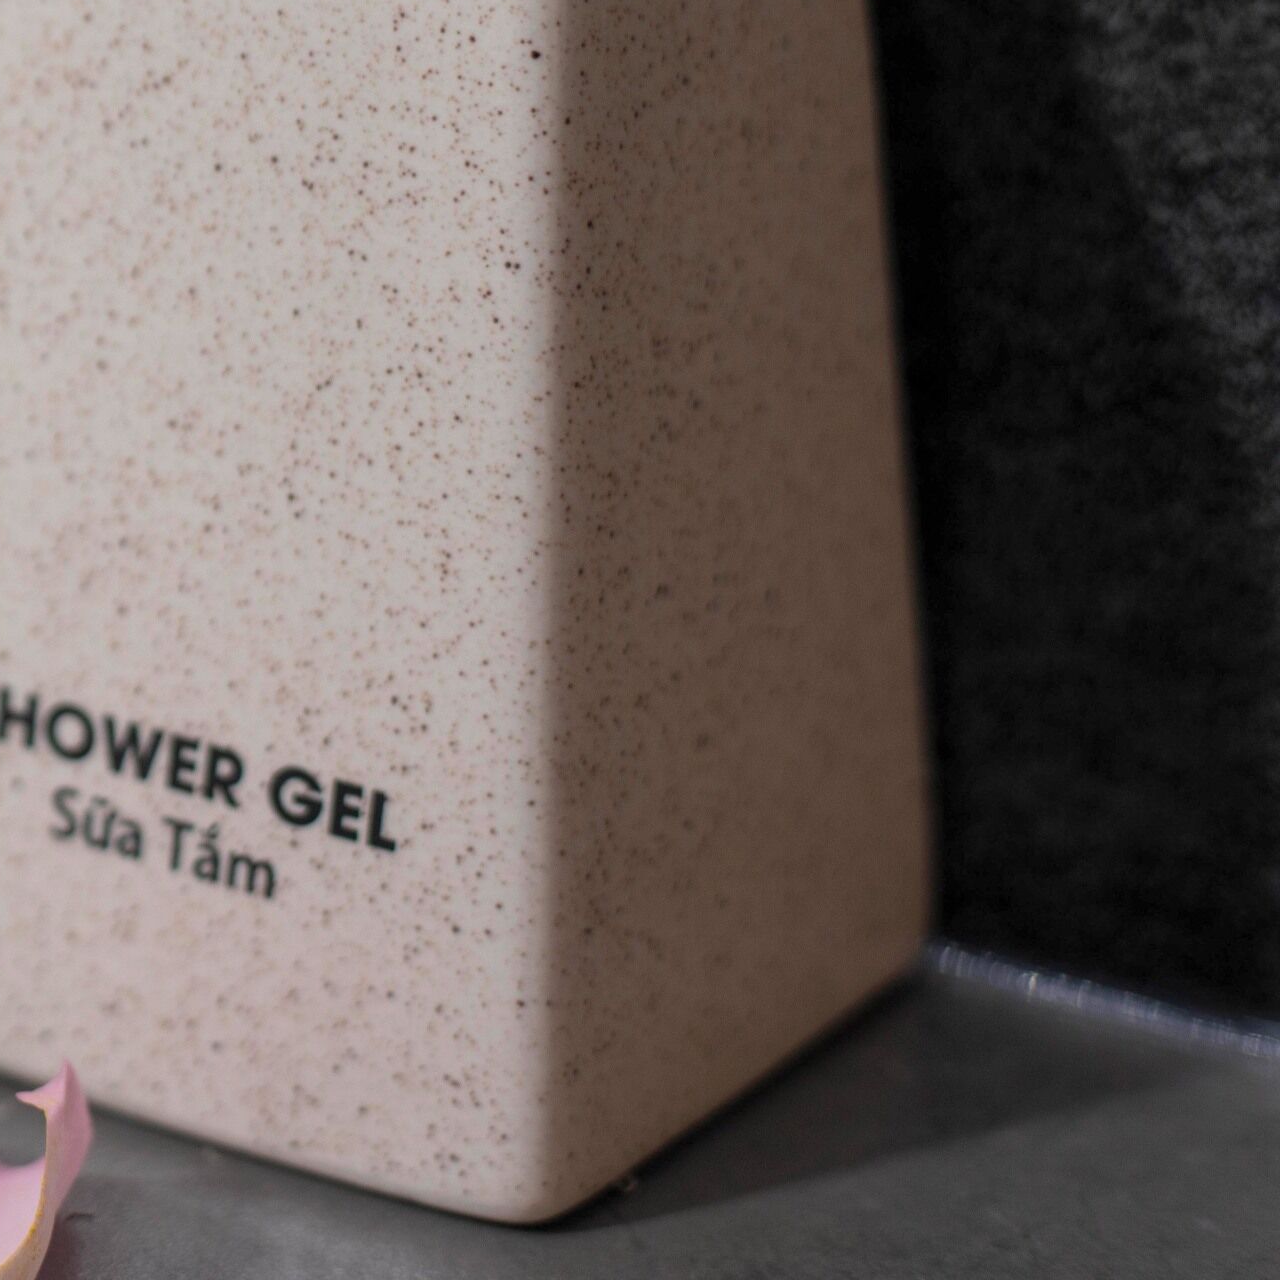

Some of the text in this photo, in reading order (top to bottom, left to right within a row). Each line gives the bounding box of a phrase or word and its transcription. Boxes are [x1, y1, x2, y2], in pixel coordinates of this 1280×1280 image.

[49, 785, 277, 900] Sữa Tắm
[268, 765, 397, 852] GEL
